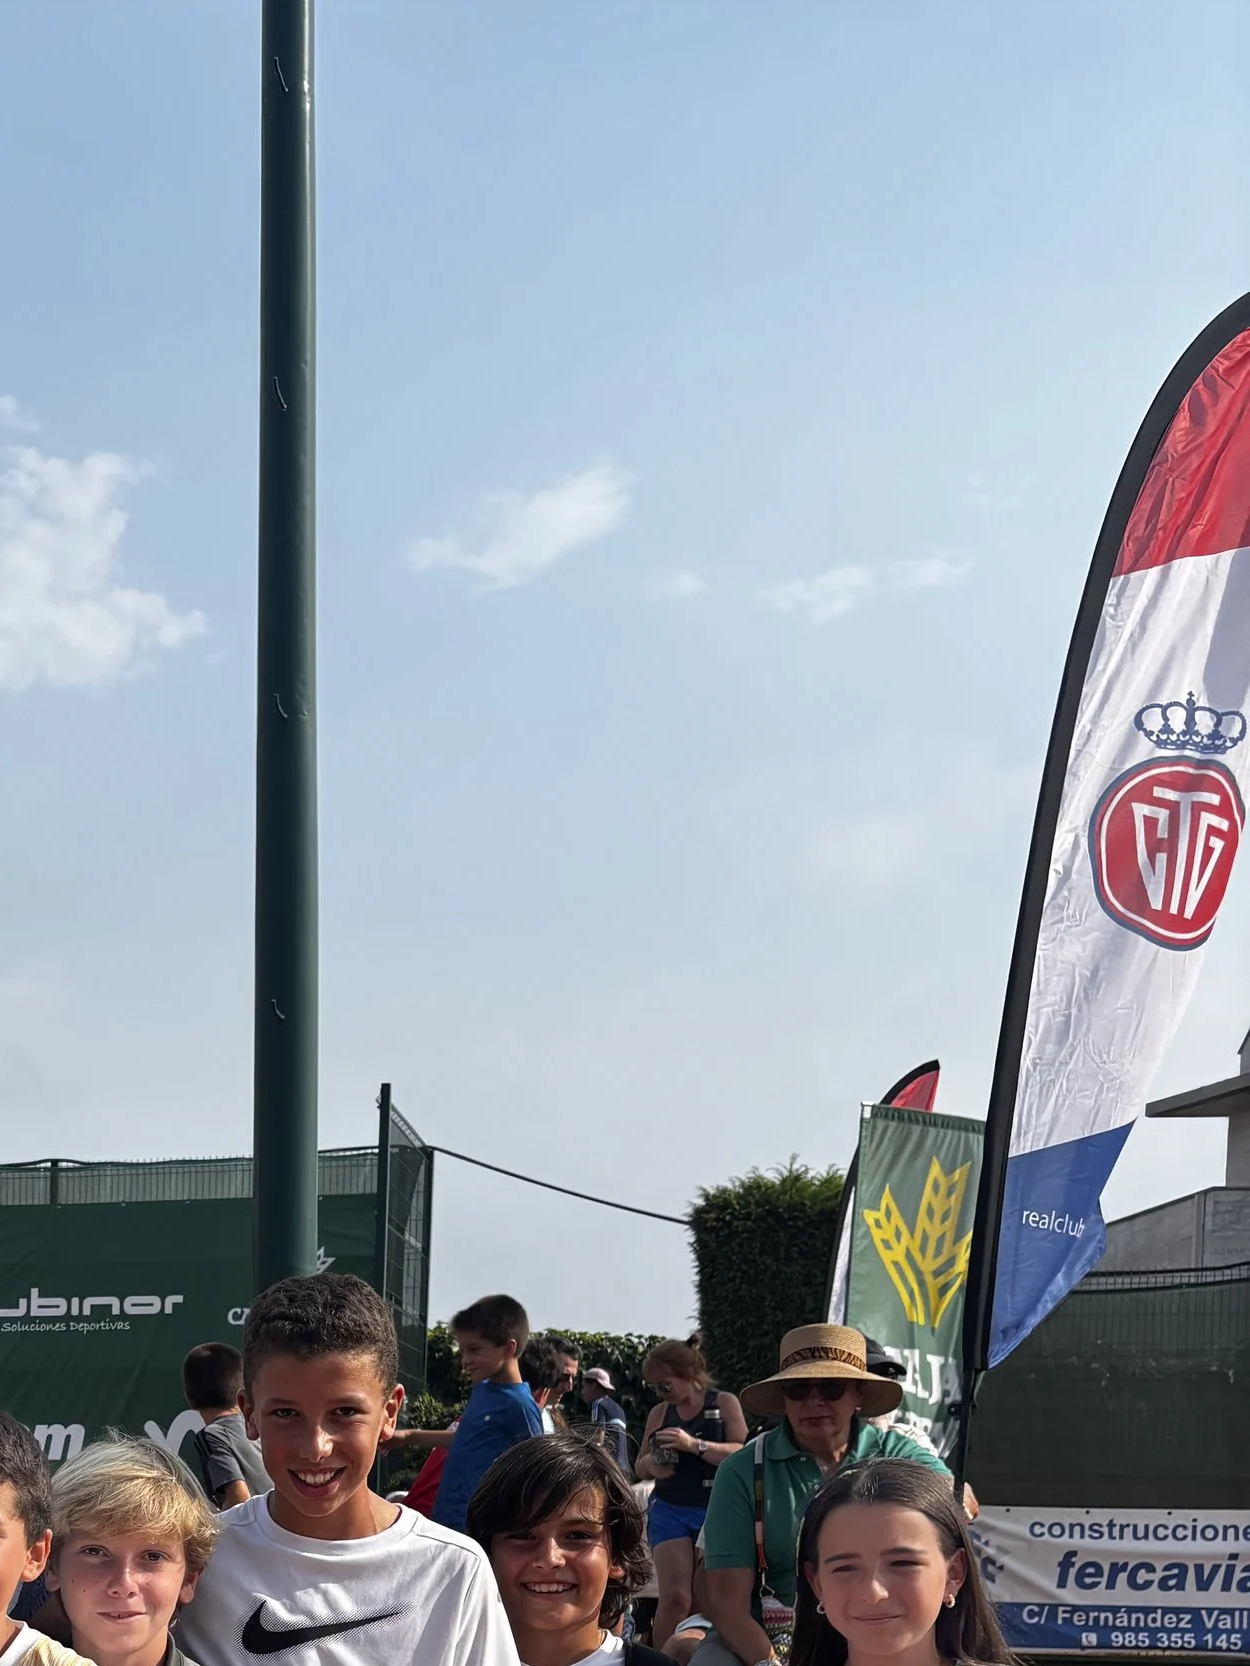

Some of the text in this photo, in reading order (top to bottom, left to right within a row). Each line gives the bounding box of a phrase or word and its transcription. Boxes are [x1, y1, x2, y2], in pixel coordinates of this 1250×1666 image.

[1022, 1210, 1085, 1238] realclub
[1, 1318, 131, 1335] Soluciones Deportivas
[1022, 1605, 1248, 1630] C/ Fernández Vall
[1110, 1631, 1242, 1650] 985 355 145
